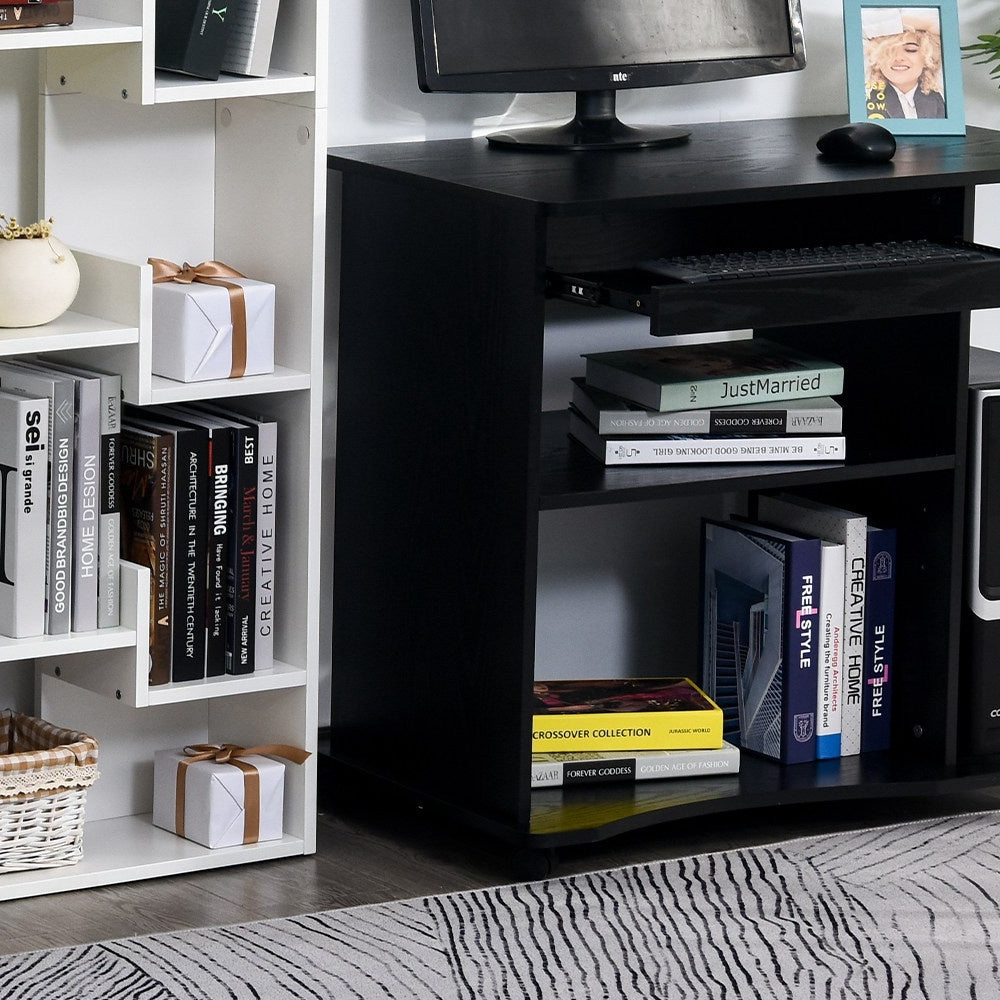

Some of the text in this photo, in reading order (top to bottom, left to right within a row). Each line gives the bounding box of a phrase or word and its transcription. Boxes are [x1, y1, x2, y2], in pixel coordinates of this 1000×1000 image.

[610, 419, 643, 428] FASHION
[644, 419, 655, 428] OF
[656, 418, 671, 427] AGE
[673, 418, 705, 427] GOLDEN
[714, 418, 750, 427] GODDESS
[751, 417, 783, 426] FOREVER
[22, 410, 45, 514] sei si grande
[108, 437, 116, 471] FOREVER
[244, 435, 254, 465] BEST
[653, 447, 673, 456] GIRL
[675, 447, 713, 455] LOOKING
[714, 447, 739, 455] GOOD
[768, 446, 789, 454] MINE
[213, 464, 229, 536] BRINGING
[81, 455, 96, 578] HOME DESION
[159, 532, 166, 547] OF
[215, 543, 224, 562] Have
[259, 455, 274, 638] CREATIVE HOME
[185, 451, 198, 659] ARCHITECTURE IN THE TWENTIETH CENTURY
[212, 605, 222, 637] lacking
[241, 614, 249, 647] ARRIVAL
[799, 574, 813, 669] FREE STYLE
[823, 613, 832, 650] Creating
[846, 557, 865, 705] CREATIVE HOME
[831, 626, 840, 712] Anderegg Architects
[872, 624, 885, 717] FREE STYLE
[823, 662, 831, 703] furniture
[822, 705, 830, 728] brand
[532, 728, 590, 740] CROSSOVER
[592, 727, 651, 738] COLLECTION
[668, 727, 693, 735] JURASSIC
[566, 768, 597, 778] FOREVER
[598, 766, 632, 776] GODDESS
[640, 763, 670, 773] GOLDEN
[672, 762, 686, 772] AGE
[687, 761, 698, 771] OF
[698, 759, 730, 770] FASHION
